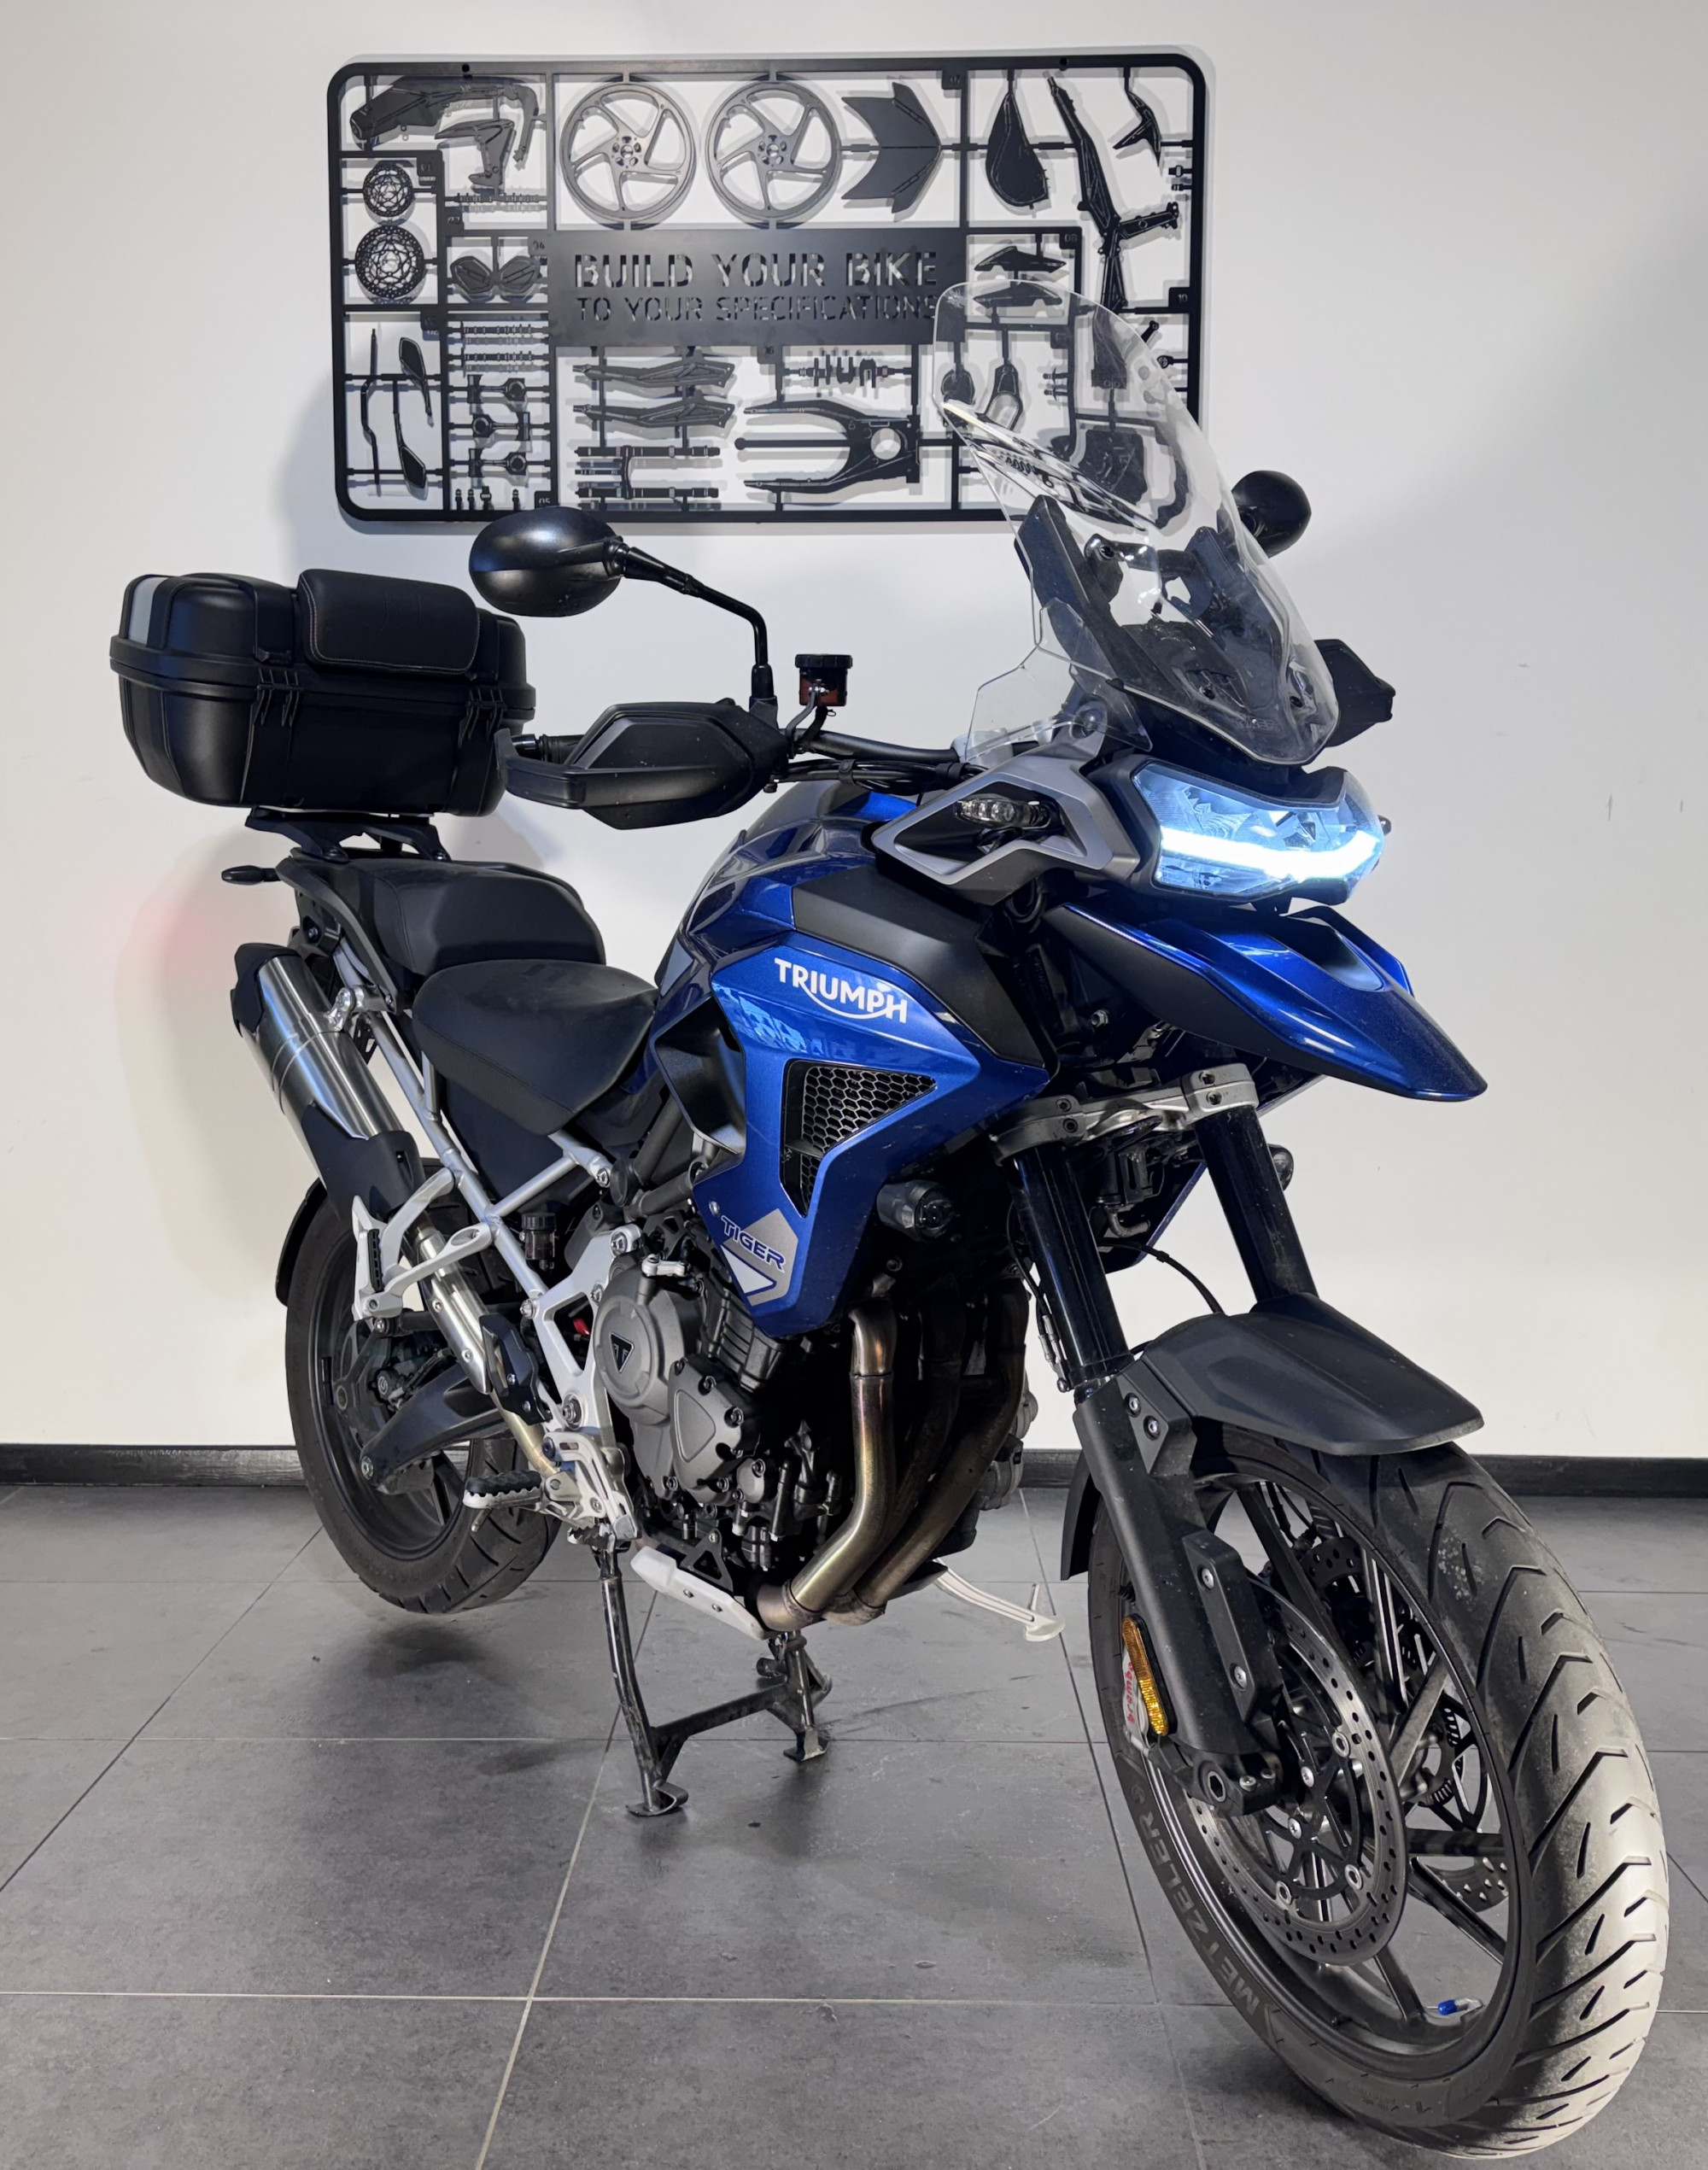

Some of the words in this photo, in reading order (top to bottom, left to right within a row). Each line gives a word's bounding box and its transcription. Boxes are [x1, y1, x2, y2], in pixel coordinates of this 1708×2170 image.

[575, 254, 693, 289] BUILD
[712, 252, 826, 288] YOUR
[845, 251, 938, 287] BIKE
[576, 296, 611, 322] TO
[624, 296, 704, 322] YOUR
[716, 295, 937, 322] SPECIFICATIONS
[774, 957, 907, 1024] TRIUMPH
[721, 1216, 786, 1273] TIGER
[1138, 1810, 1261, 2017] METZELER
